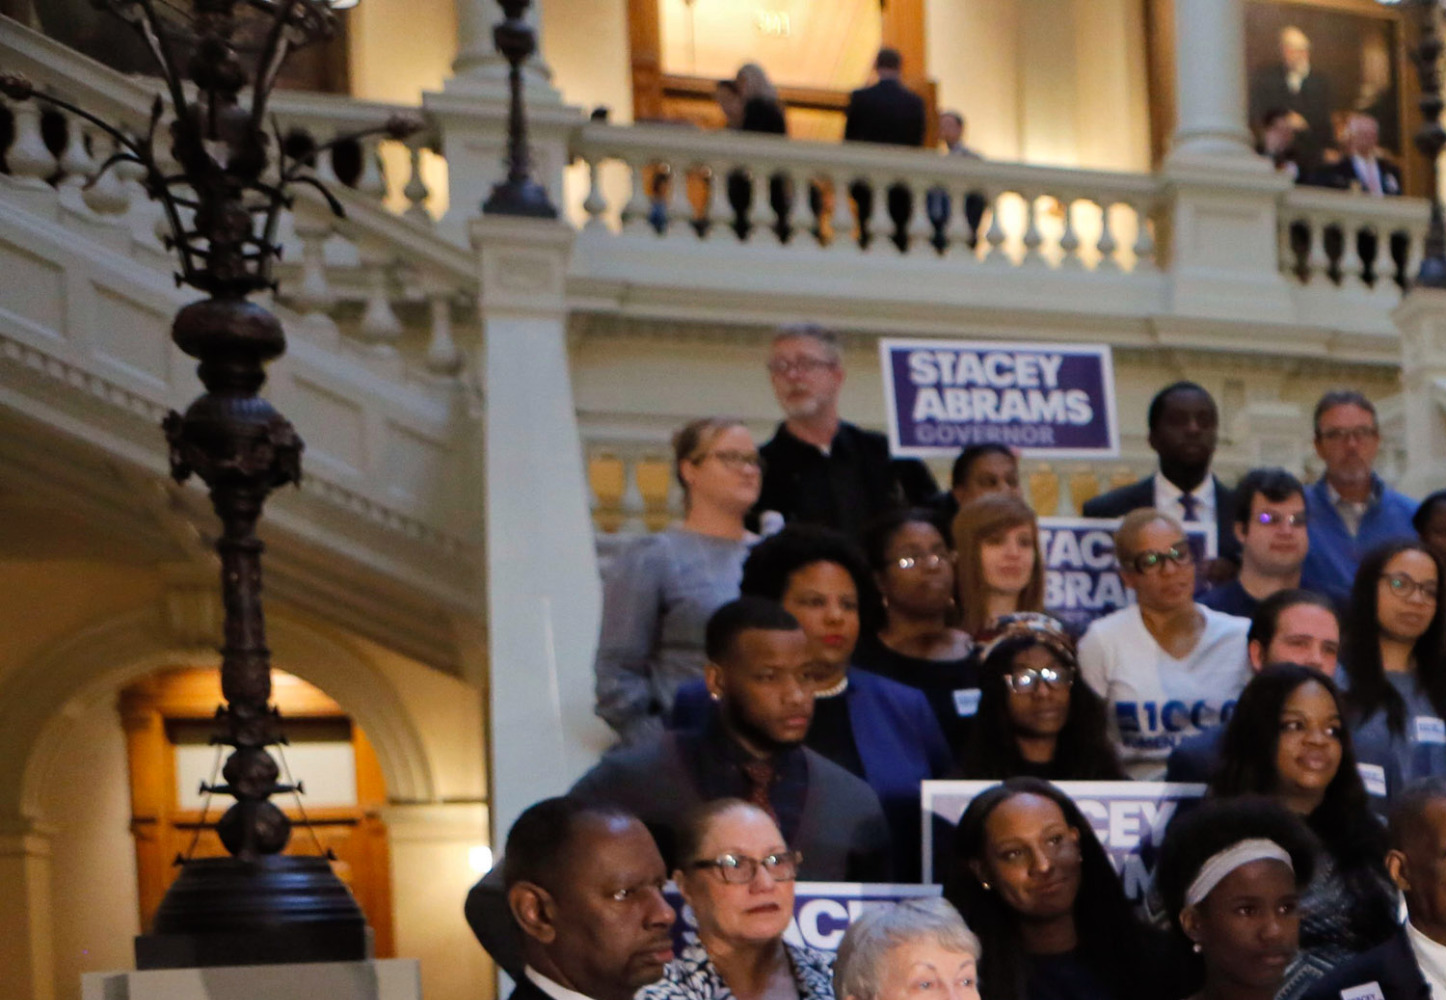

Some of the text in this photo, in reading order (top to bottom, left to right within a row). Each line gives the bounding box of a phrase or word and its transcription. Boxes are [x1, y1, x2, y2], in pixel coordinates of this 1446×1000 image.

[908, 351, 1064, 387] STACEY
[912, 386, 1094, 425] ABRAMS
[914, 423, 1056, 445] GOVERNOR
[1040, 529, 1120, 570] TAC
[1043, 571, 1128, 610] BRA
[1079, 800, 1177, 848] CEY
